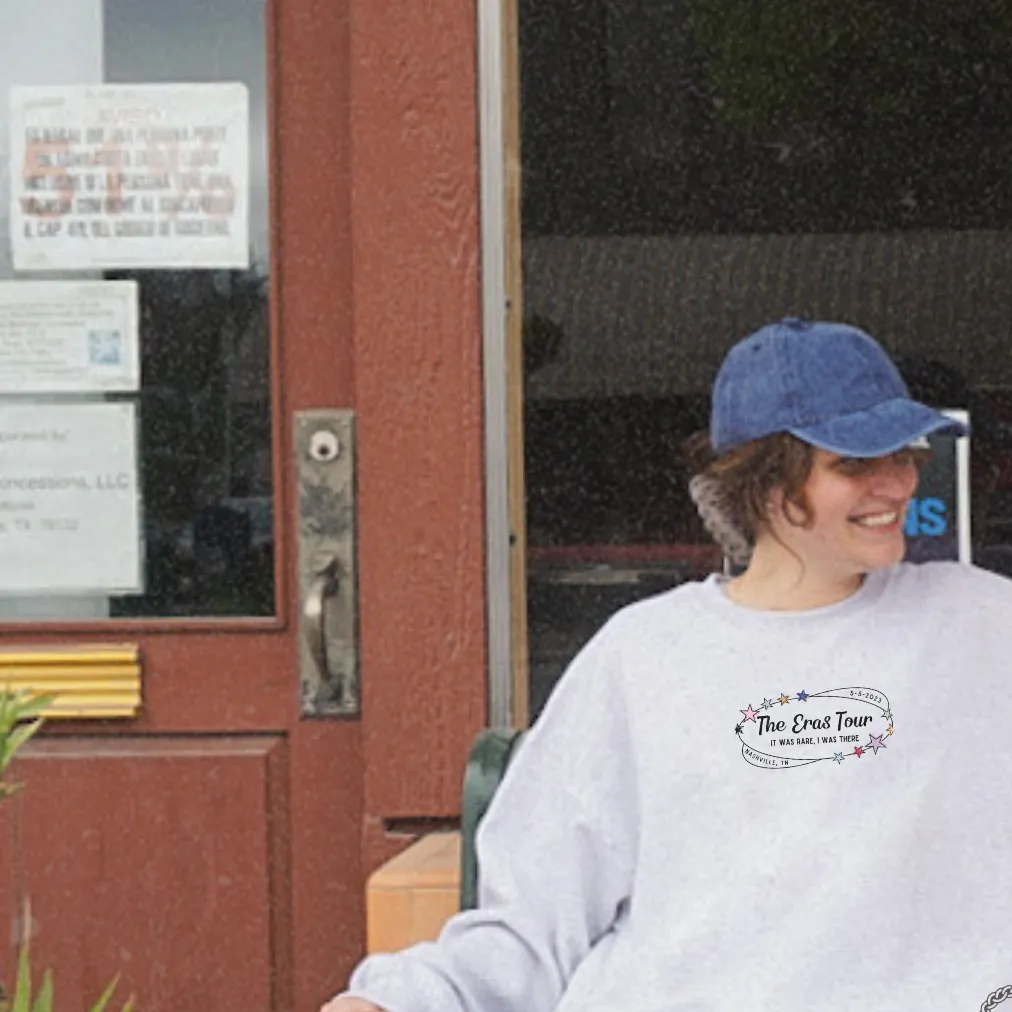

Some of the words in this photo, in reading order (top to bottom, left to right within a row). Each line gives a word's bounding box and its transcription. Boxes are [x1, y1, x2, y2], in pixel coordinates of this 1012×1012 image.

[96, 474, 128, 490] LLC
[757, 715, 786, 736] The
[792, 713, 831, 734] Eras
[835, 711, 873, 731] Tour
[770, 739, 777, 747] IT
[779, 738, 795, 746] WAS
[796, 738, 816, 746] RARE,
[821, 736, 838, 744] WAS
[839, 735, 860, 743] THERE
